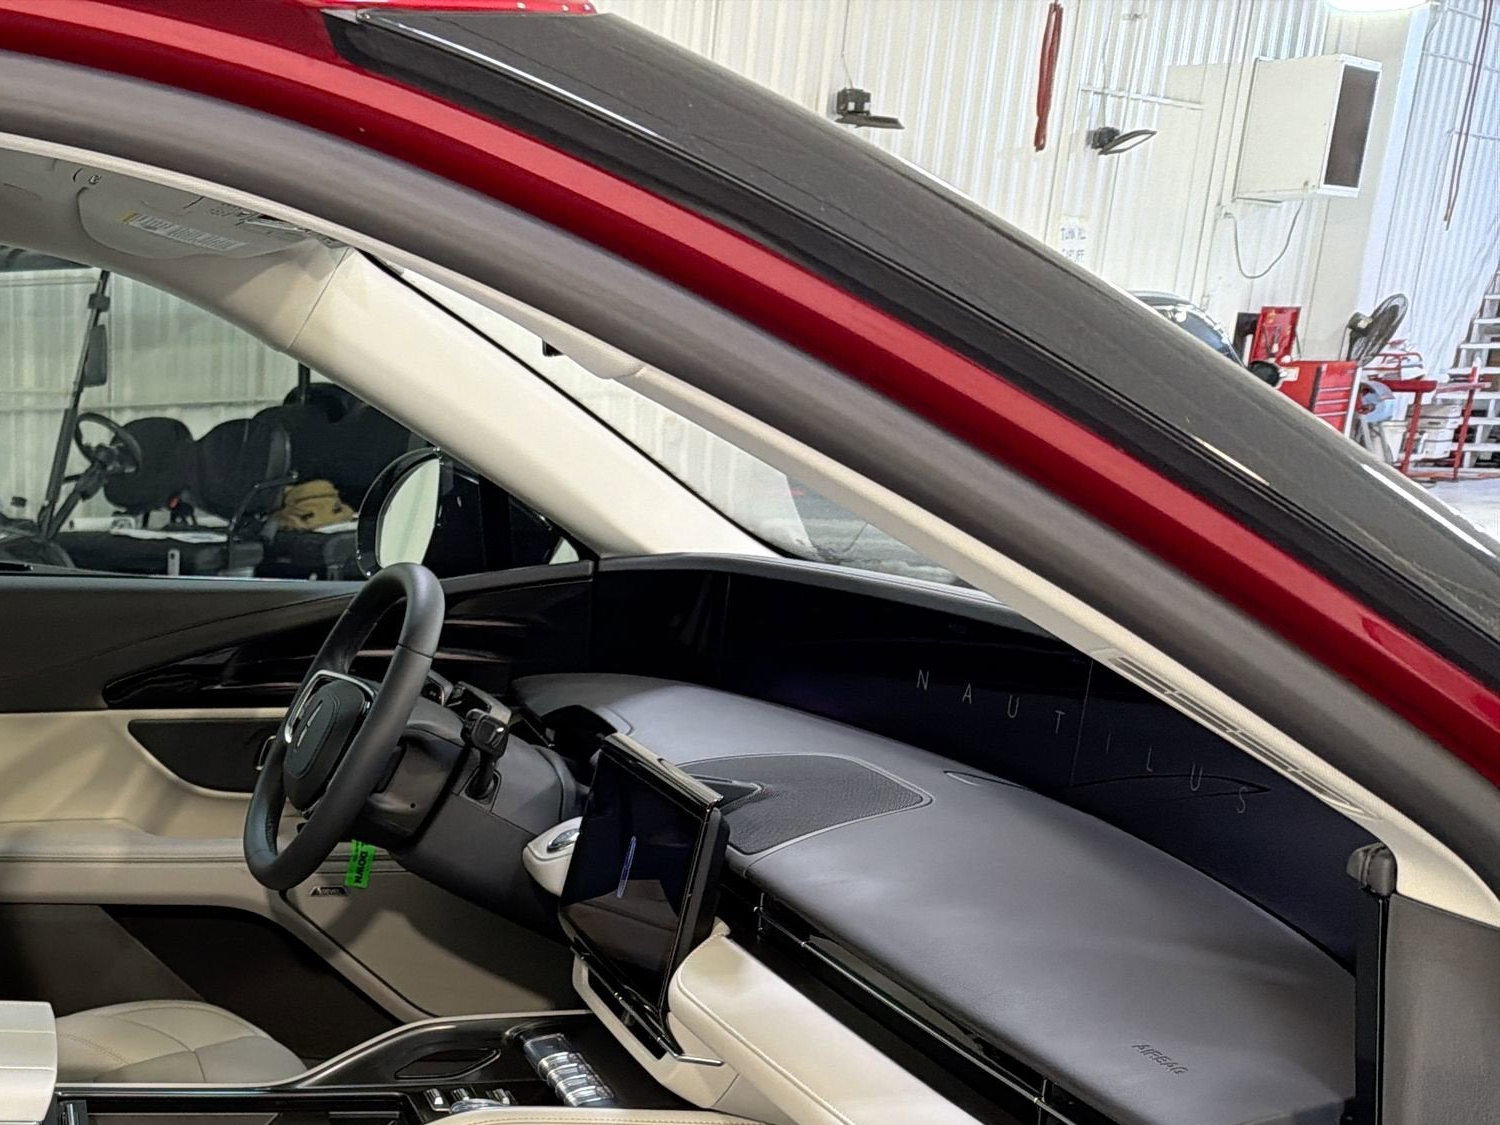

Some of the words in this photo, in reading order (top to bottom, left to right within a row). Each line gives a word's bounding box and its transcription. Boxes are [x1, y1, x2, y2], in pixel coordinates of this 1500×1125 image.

[915, 668, 1248, 815] NAUTILUS
[353, 850, 369, 884] DOWN
[1131, 1043, 1189, 1075] AIRBAG
